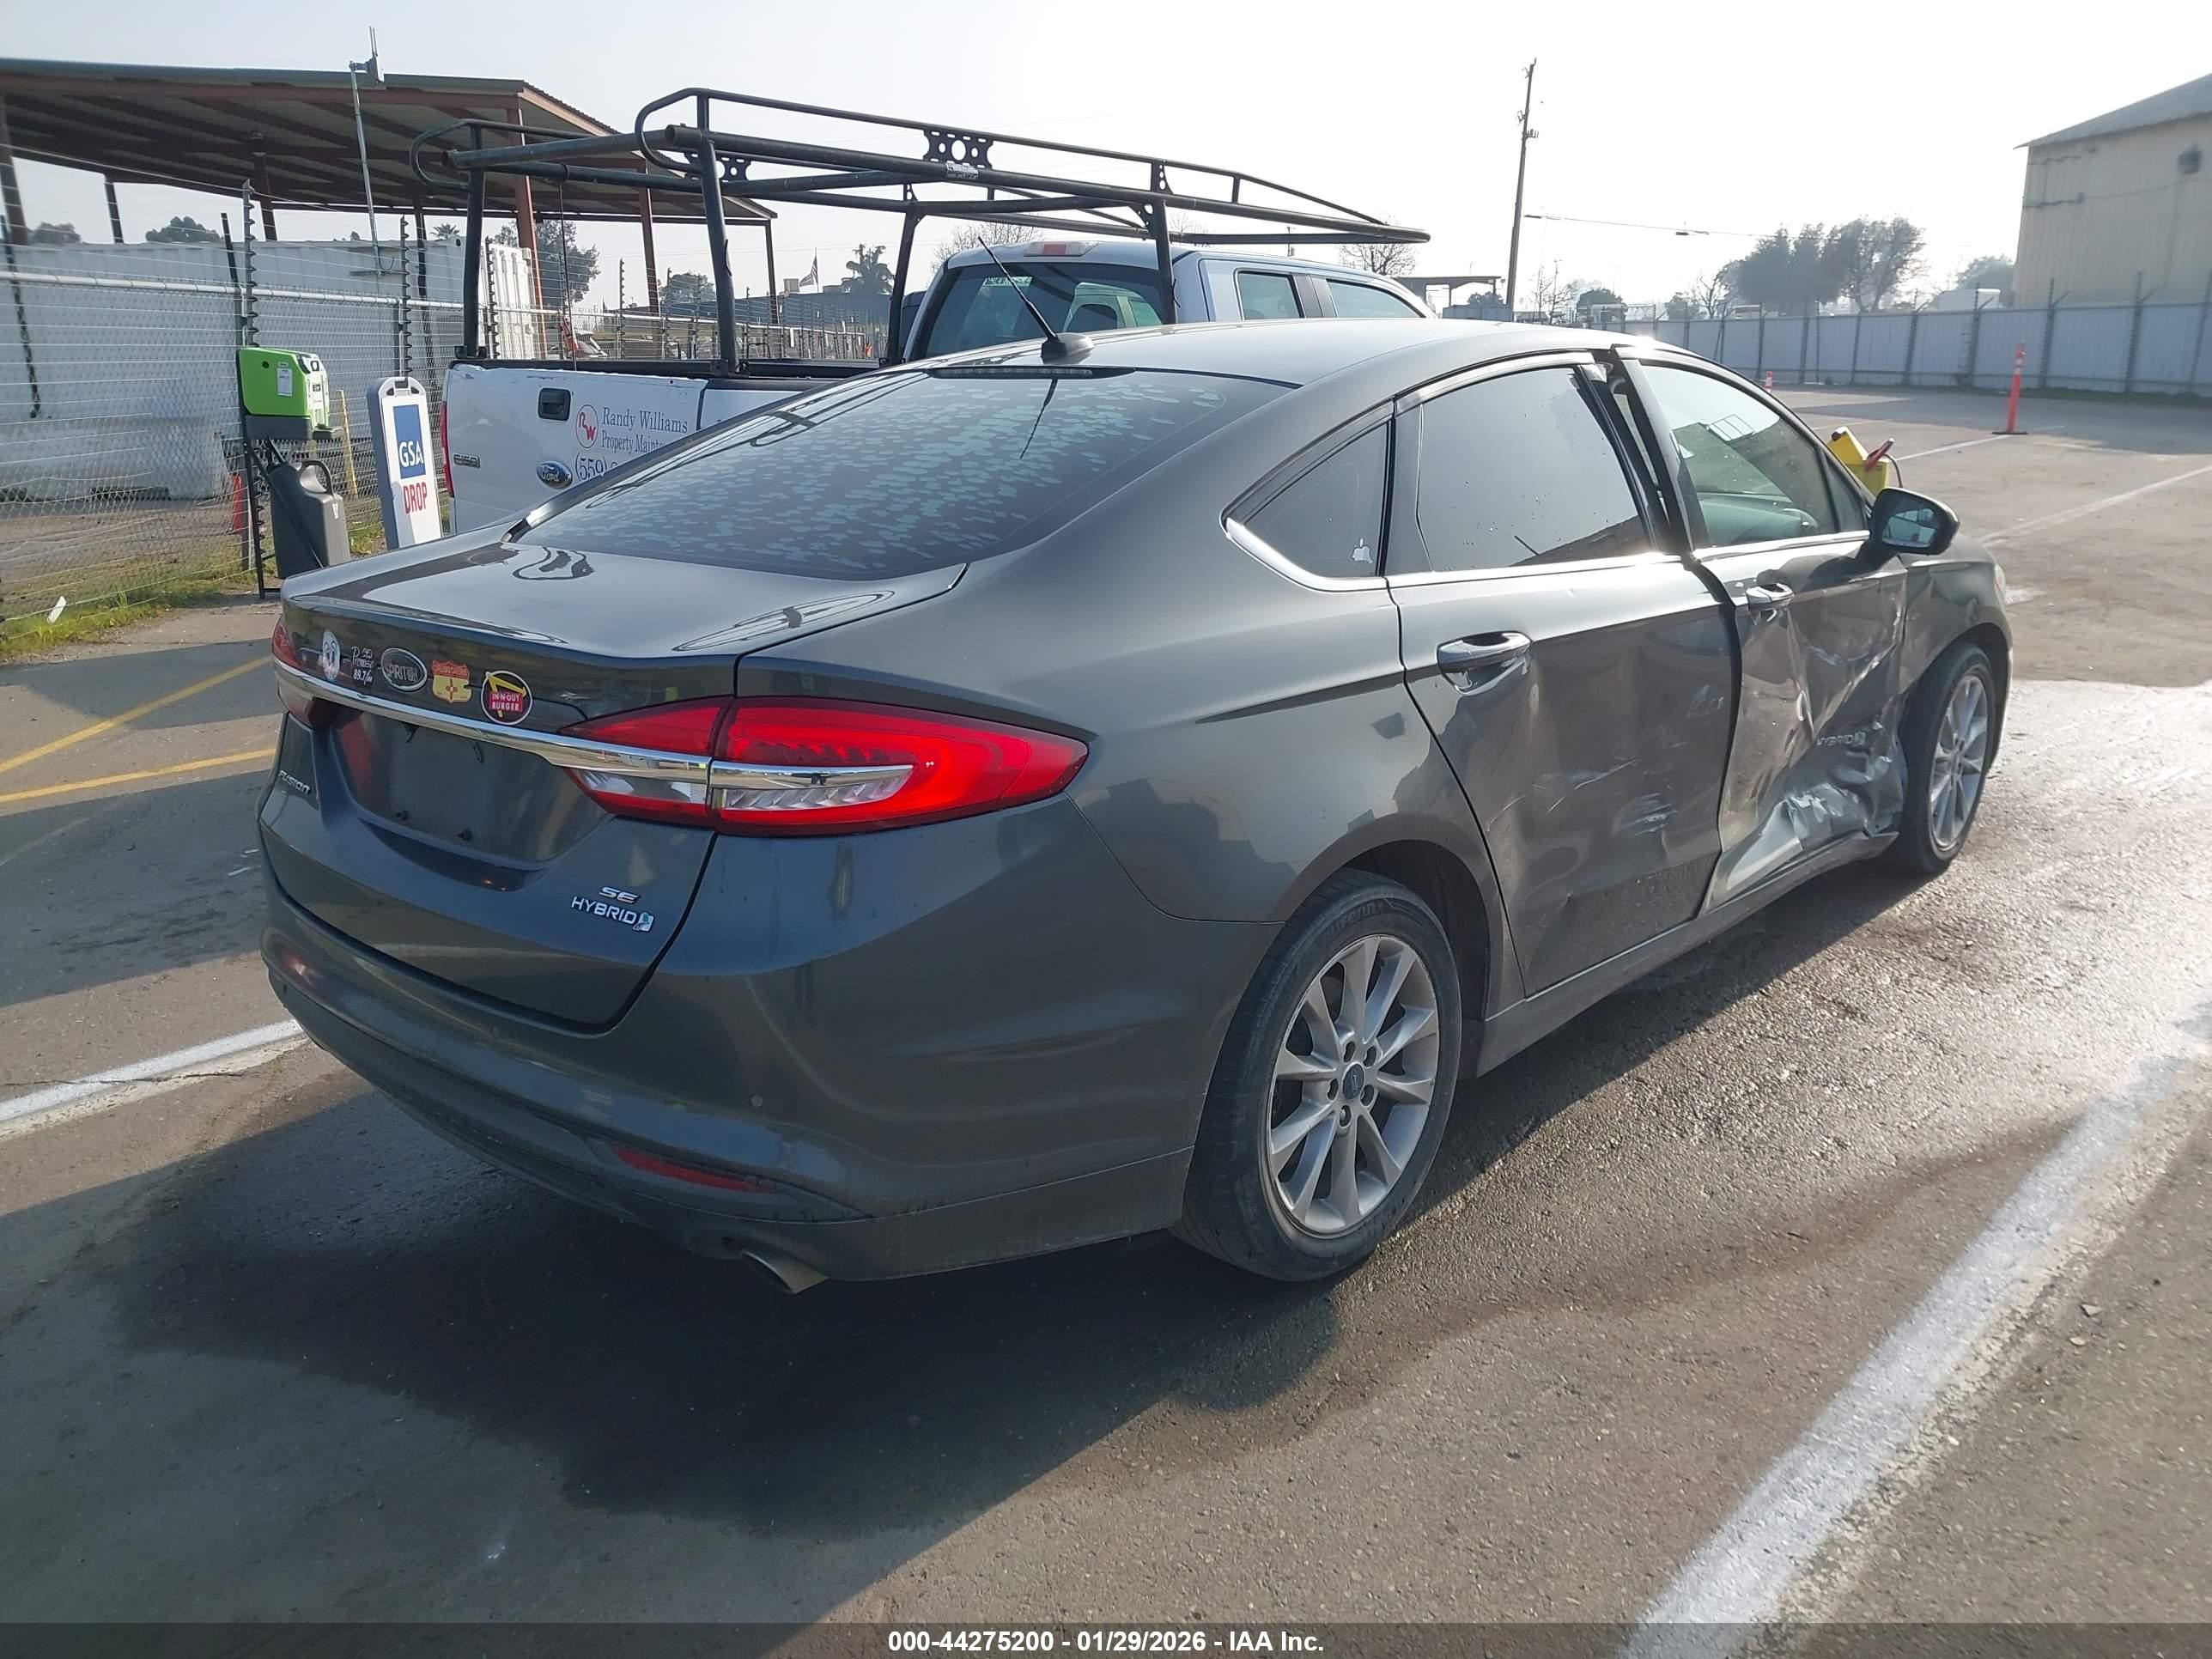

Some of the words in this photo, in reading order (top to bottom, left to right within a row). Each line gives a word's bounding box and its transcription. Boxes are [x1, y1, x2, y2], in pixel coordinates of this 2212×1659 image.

[603, 406, 635, 430] Randy
[639, 410, 688, 434] Williams
[399, 441, 424, 467] GSA
[601, 430, 634, 454] Property
[542, 465, 561, 482] Ford
[403, 482, 428, 514] DROP
[492, 701, 520, 712] BURGER
[599, 886, 640, 904] SE
[571, 896, 637, 925] HYBRID
